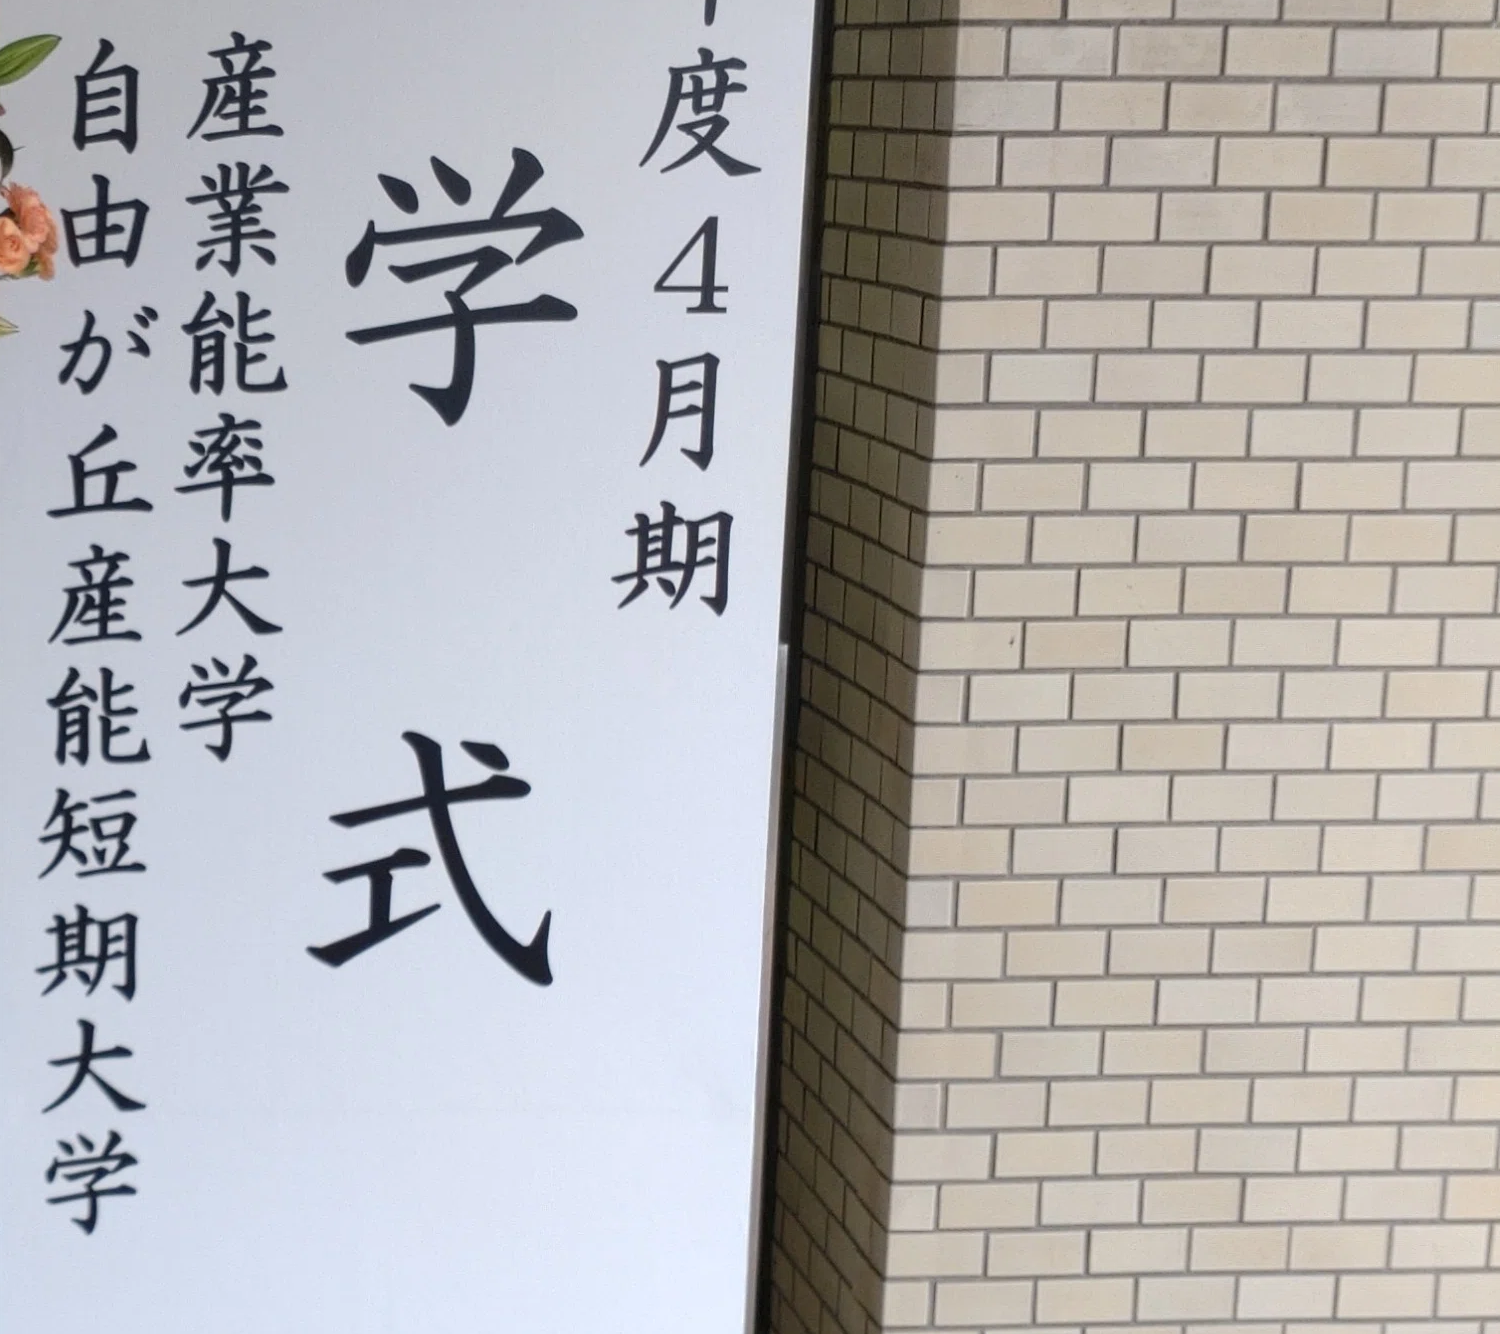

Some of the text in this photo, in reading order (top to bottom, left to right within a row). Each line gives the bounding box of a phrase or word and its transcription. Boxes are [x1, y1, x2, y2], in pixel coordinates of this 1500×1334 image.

[35, 35, 158, 1234] 自由が丘産能短期大学
[174, 32, 290, 762] 産業能率大学
